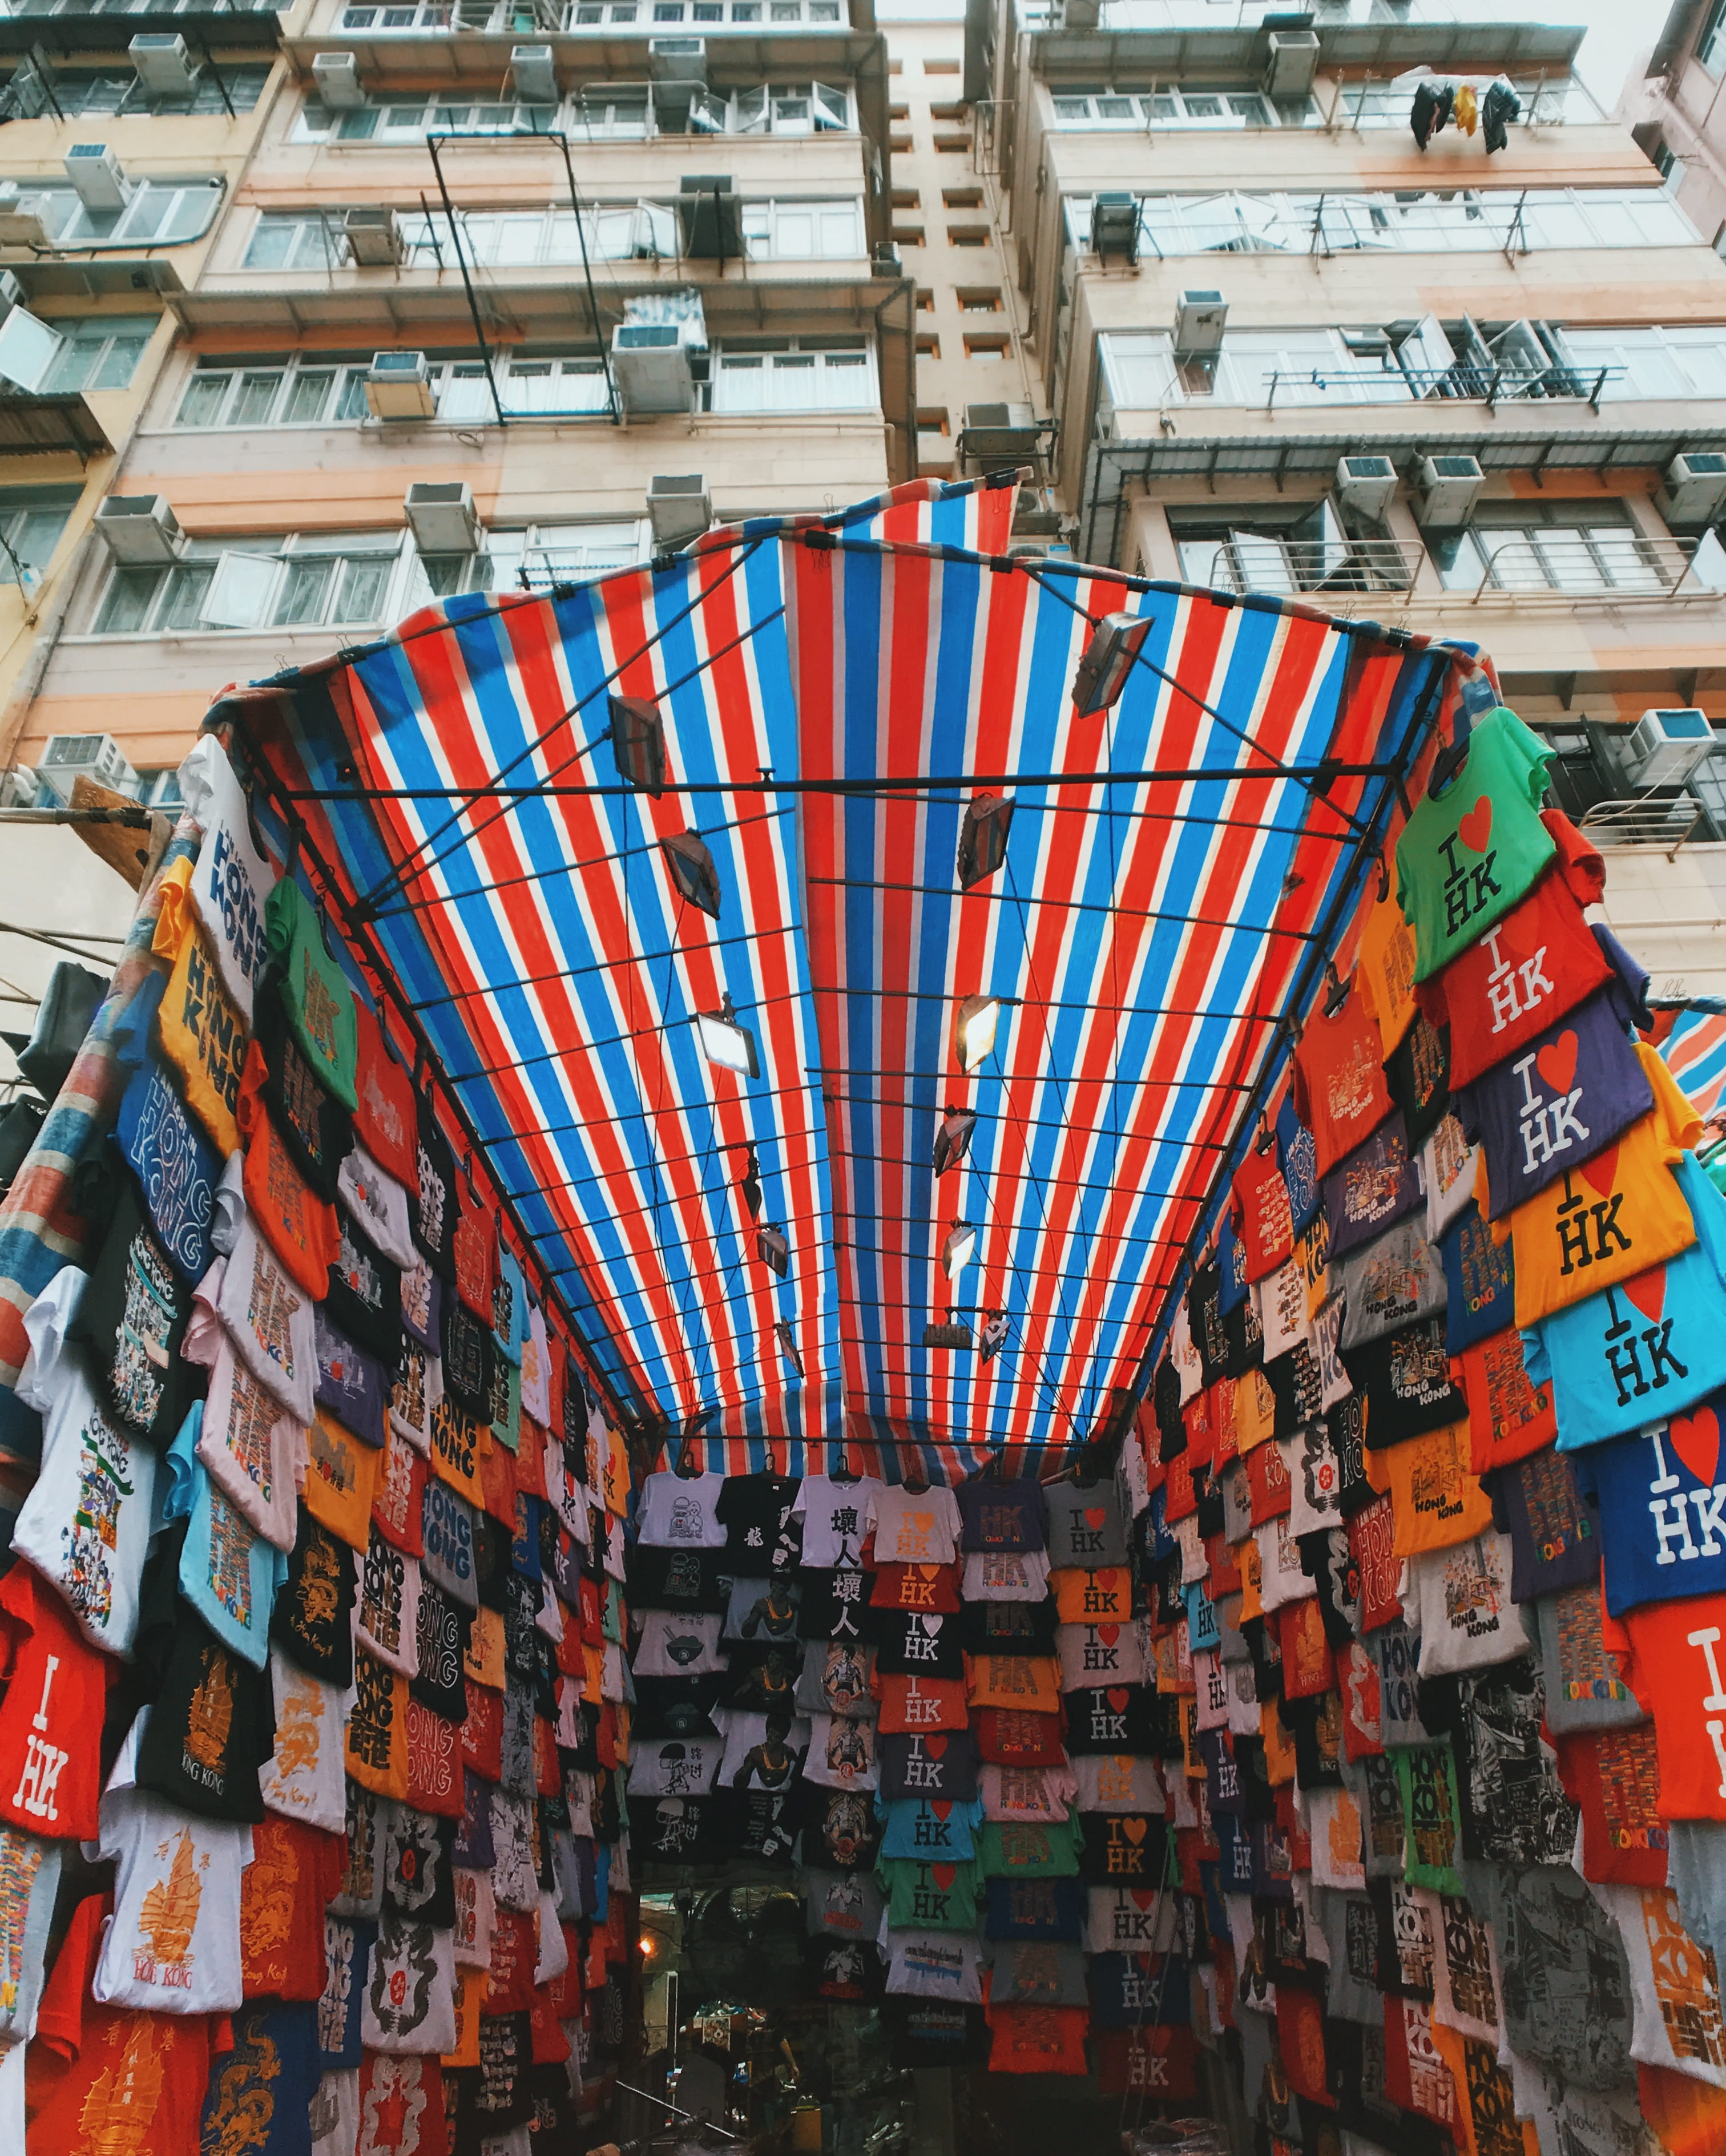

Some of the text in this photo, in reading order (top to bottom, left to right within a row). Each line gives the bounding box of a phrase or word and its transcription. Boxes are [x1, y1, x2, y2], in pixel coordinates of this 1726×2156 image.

[1438, 830, 1466, 890] I
[213, 830, 267, 965] HONG
[1443, 849, 1502, 938] HK
[1481, 923, 1510, 984] I
[1486, 946, 1554, 1034] HK
[1513, 1052, 1543, 1117] I
[1333, 1096, 1358, 1122] HONG
[1350, 1091, 1374, 1120] KONG
[1519, 1087, 1591, 1175] HK
[1557, 1168, 1584, 1216] I
[1349, 1196, 1378, 1223] HONG
[1368, 1196, 1397, 1223] KONG
[1556, 1192, 1632, 1276] HK
[1365, 1295, 1397, 1315] HONG
[1384, 1299, 1418, 1321] KONG
[1604, 1286, 1632, 1342] I
[1605, 1317, 1689, 1408] HK
[1396, 1379, 1430, 1399] HONG
[1419, 1383, 1451, 1406] KONG
[1640, 1418, 1680, 1494] I
[1415, 1493, 1447, 1514] HONG
[1437, 1500, 1464, 1521] KONG
[901, 1512, 911, 1534] I
[1069, 1508, 1084, 1531] I
[1648, 1483, 1726, 1565] HK
[830, 1505, 860, 1568] 壞人
[896, 1535, 930, 1557] HK
[1071, 1531, 1106, 1553] HK
[902, 1563, 917, 1580] I
[1084, 1568, 1099, 1591] I
[830, 1570, 862, 1637] 壞人
[899, 1581, 935, 1606] HK
[1083, 1592, 1119, 1613] HK
[417, 1594, 458, 1650] ONG
[907, 1611, 920, 1636] I
[1197, 1604, 1216, 1638] HK
[1450, 1608, 1477, 1629] HONG
[1467, 1615, 1500, 1638] KONG
[904, 1636, 938, 1661] HK
[1084, 1624, 1098, 1647] I
[416, 1633, 458, 1688] ONG
[1083, 1648, 1119, 1670] HK
[33, 1653, 59, 1731] I
[907, 1674, 921, 1697] I
[904, 1699, 942, 1723] HK
[1090, 1689, 1106, 1715] I
[408, 1701, 454, 1758] ONG
[1090, 1715, 1128, 1741] HK
[908, 1734, 924, 1760] I
[13, 1734, 69, 1821] HK
[408, 1746, 451, 1796] ONG
[904, 1761, 944, 1788] HK
[1217, 1763, 1240, 1799] HK
[1098, 1776, 1136, 1802] HK
[916, 1799, 931, 1820] I
[913, 1822, 951, 1847] HK
[1106, 1818, 1123, 1846] I
[1609, 1827, 1670, 1850] HONGKO
[1106, 1848, 1145, 1874] HK
[916, 1862, 931, 1891] I
[913, 1893, 951, 1921] HK
[1114, 1887, 1130, 1912] I
[1113, 1913, 1154, 1940] HK
[161, 1966, 193, 1989] KONG
[1122, 1953, 1138, 1979] I
[1121, 1980, 1161, 2008] HK
[1128, 2056, 1170, 2086] HK
